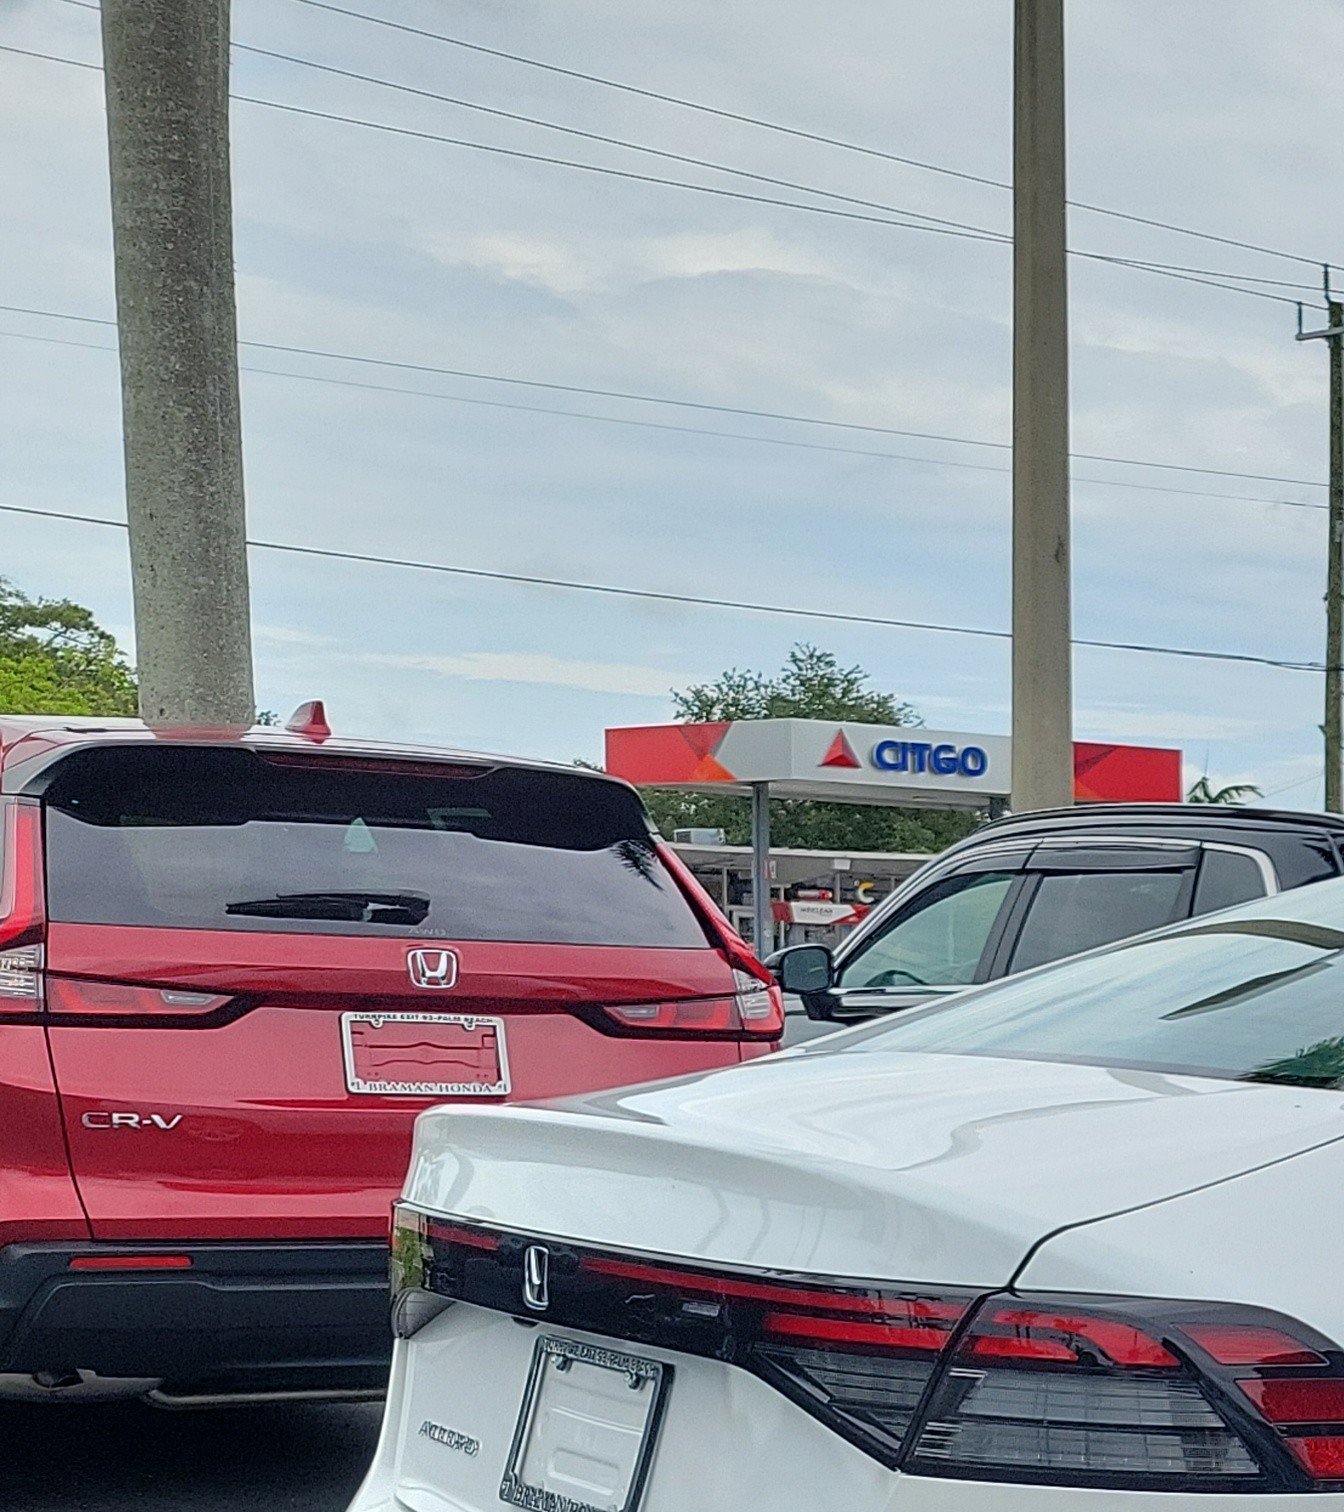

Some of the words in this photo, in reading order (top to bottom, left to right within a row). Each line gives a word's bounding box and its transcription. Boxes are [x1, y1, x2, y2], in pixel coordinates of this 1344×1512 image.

[873, 740, 989, 777] CITGO
[367, 1082, 437, 1092] BRAMAN
[438, 1083, 493, 1093] HONDA
[81, 1112, 183, 1129] CR-V
